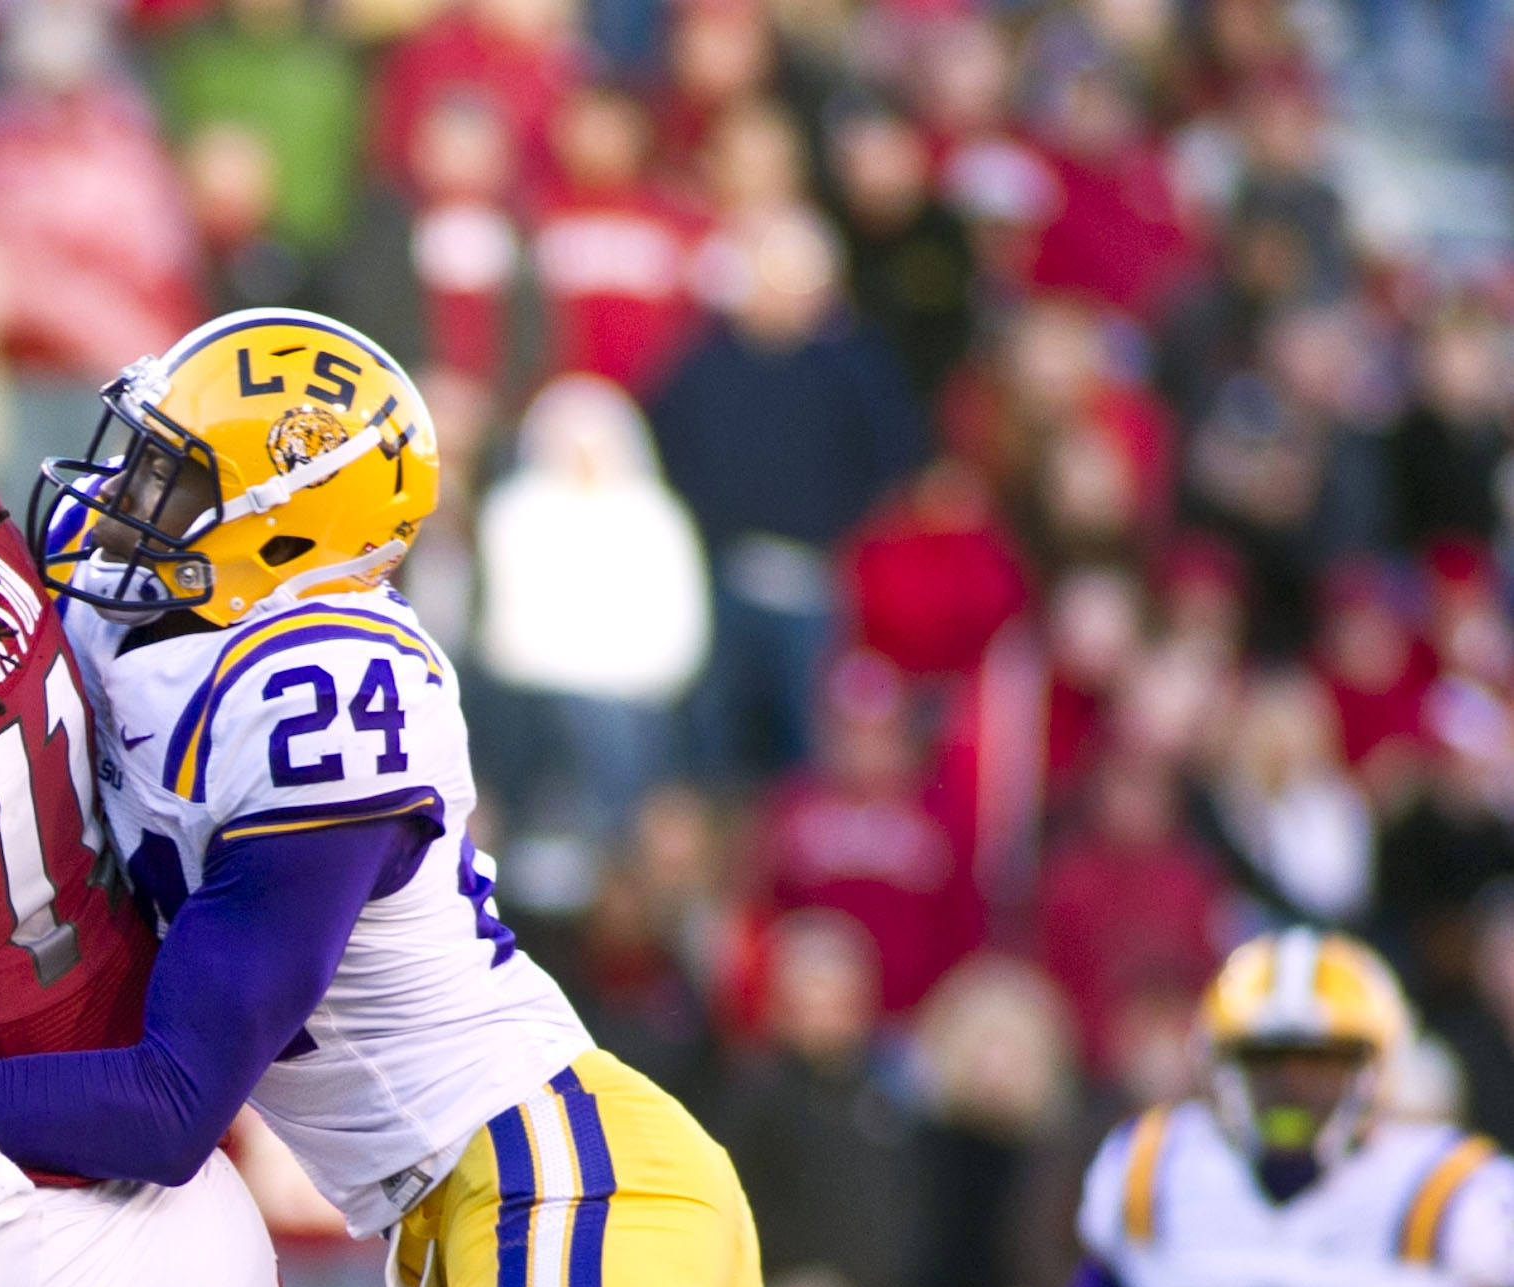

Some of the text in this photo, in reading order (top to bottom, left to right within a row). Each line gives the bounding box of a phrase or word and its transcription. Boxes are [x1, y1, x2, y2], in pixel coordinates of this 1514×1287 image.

[237, 348, 417, 461] LSU
[97, 757, 123, 791] SU
[262, 658, 408, 787] 24
